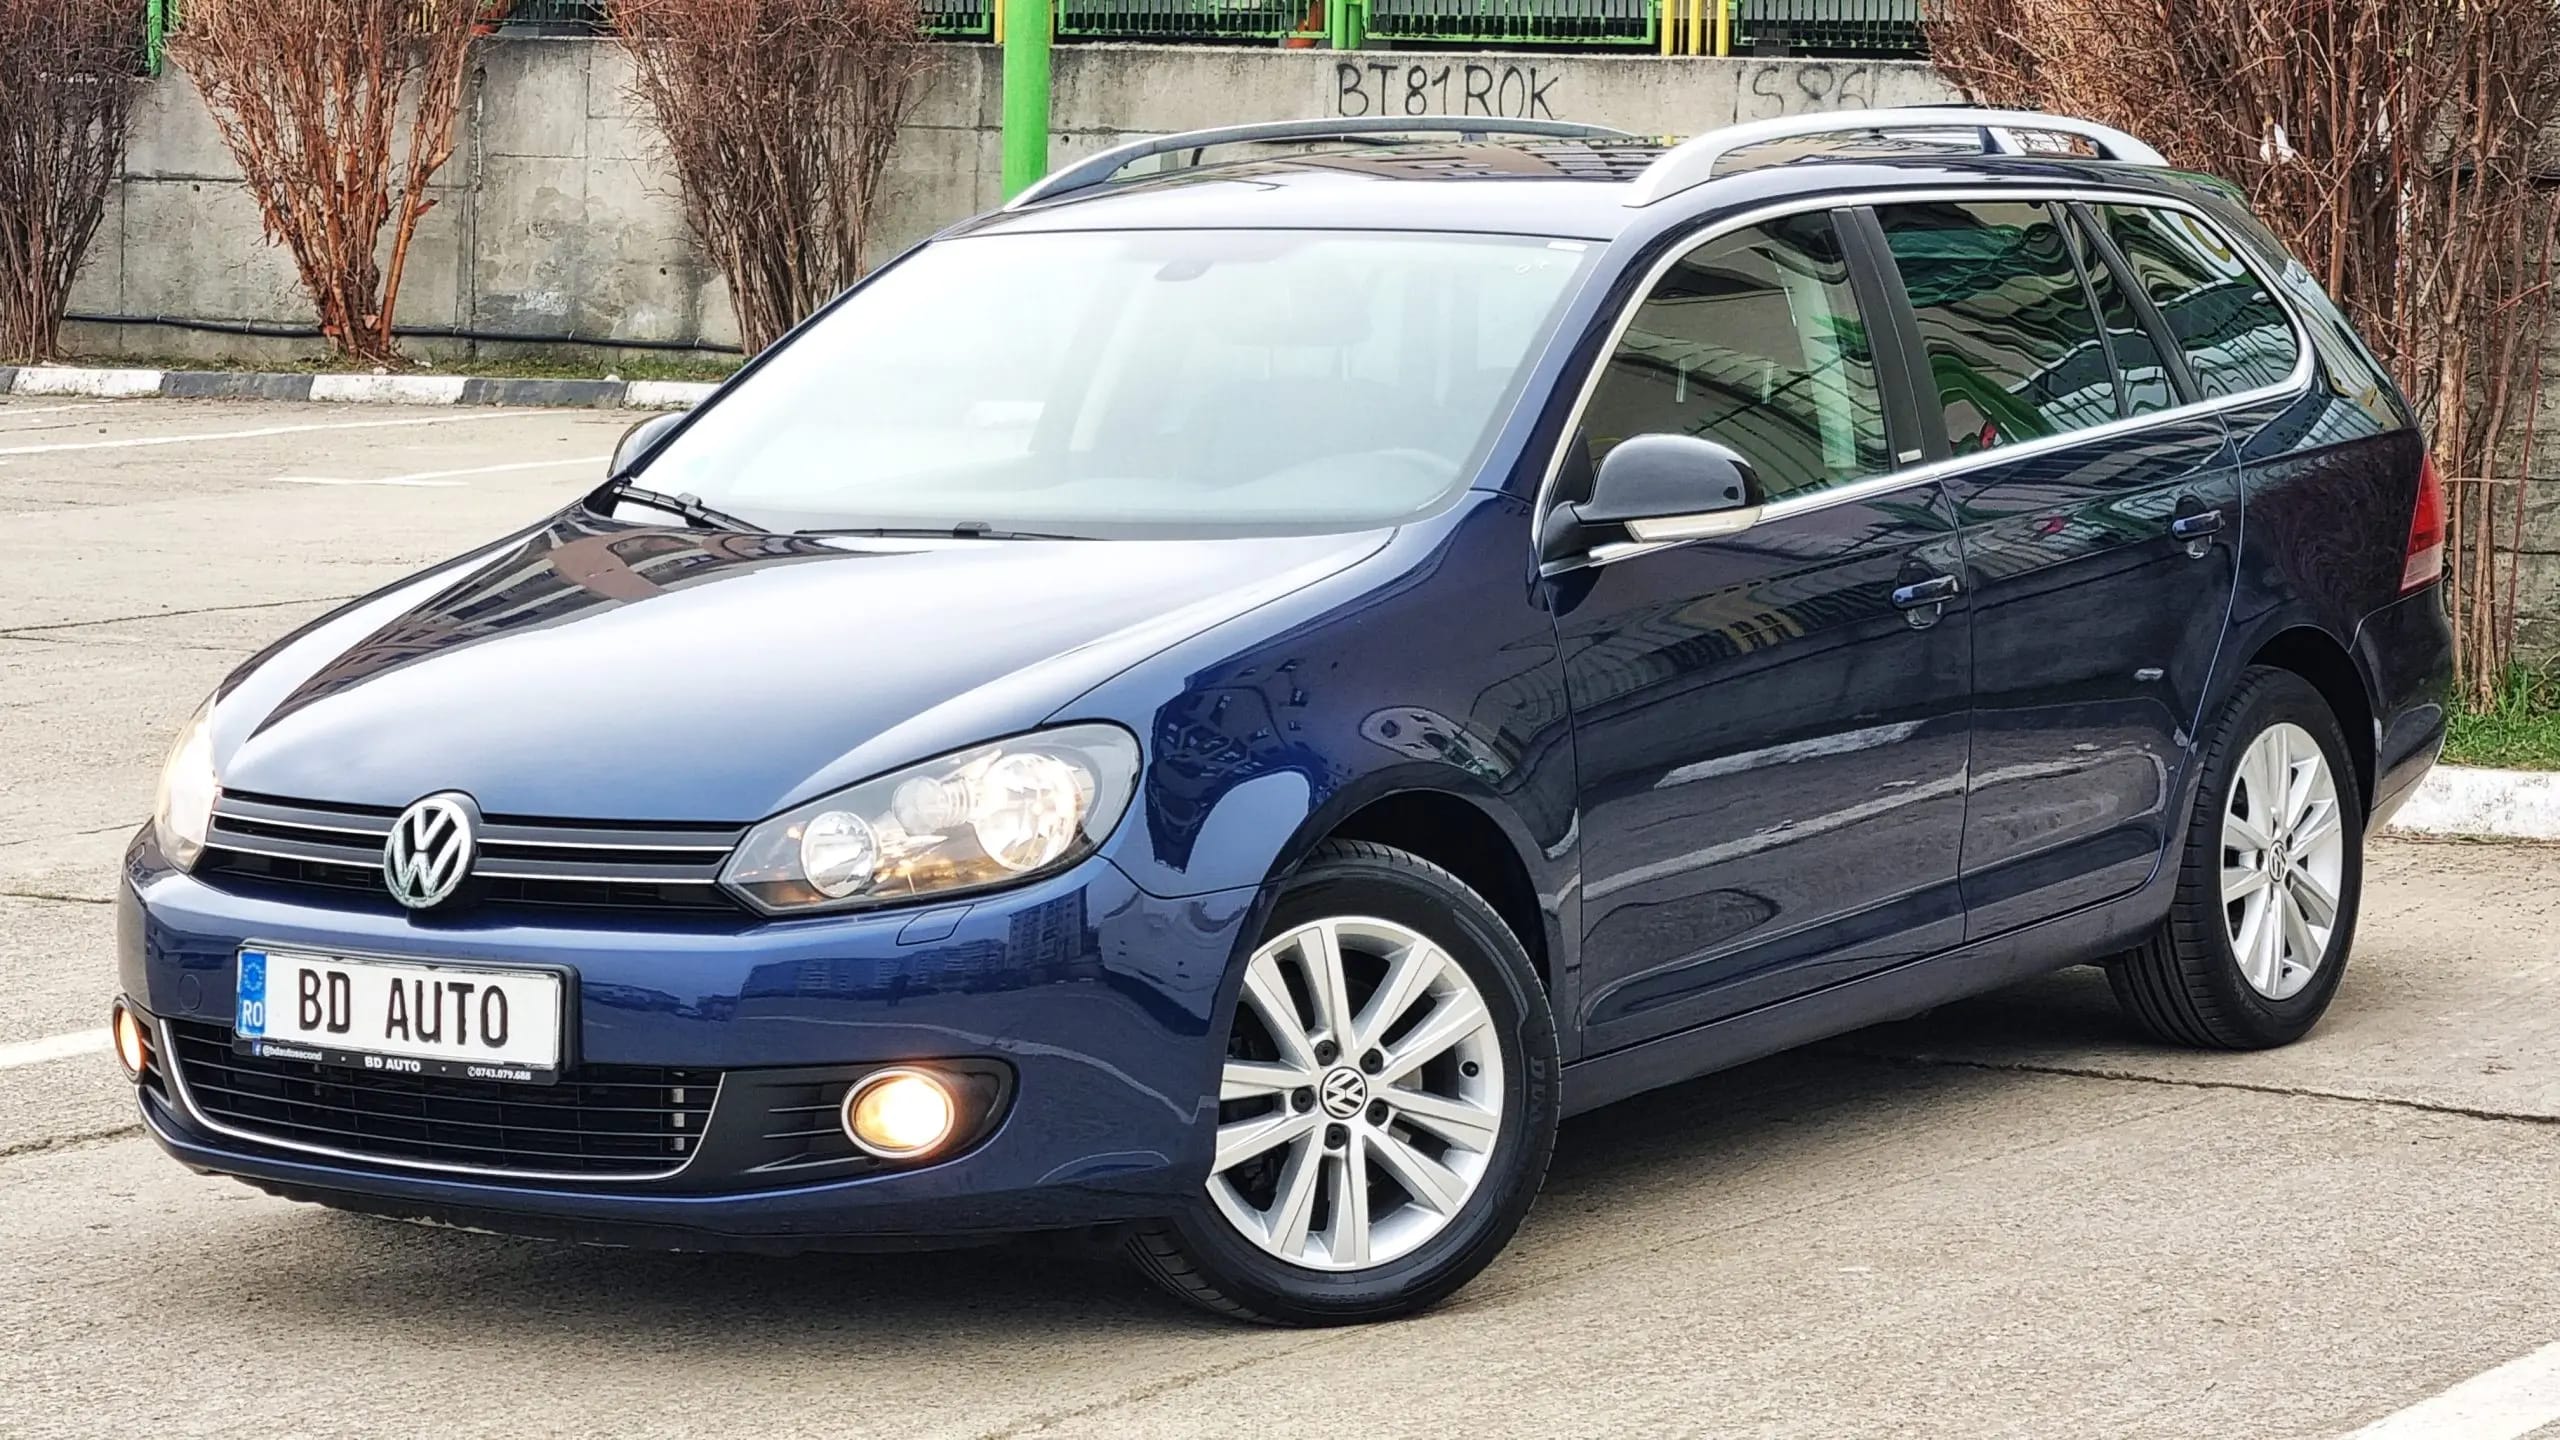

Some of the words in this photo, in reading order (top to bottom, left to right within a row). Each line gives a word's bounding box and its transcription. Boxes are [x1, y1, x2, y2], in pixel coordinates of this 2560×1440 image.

[243, 999, 263, 1027] RO
[299, 968, 350, 1034] BD
[385, 977, 508, 1048] AUTO
[364, 1056, 382, 1068] BD
[385, 1058, 421, 1072] AUTO
